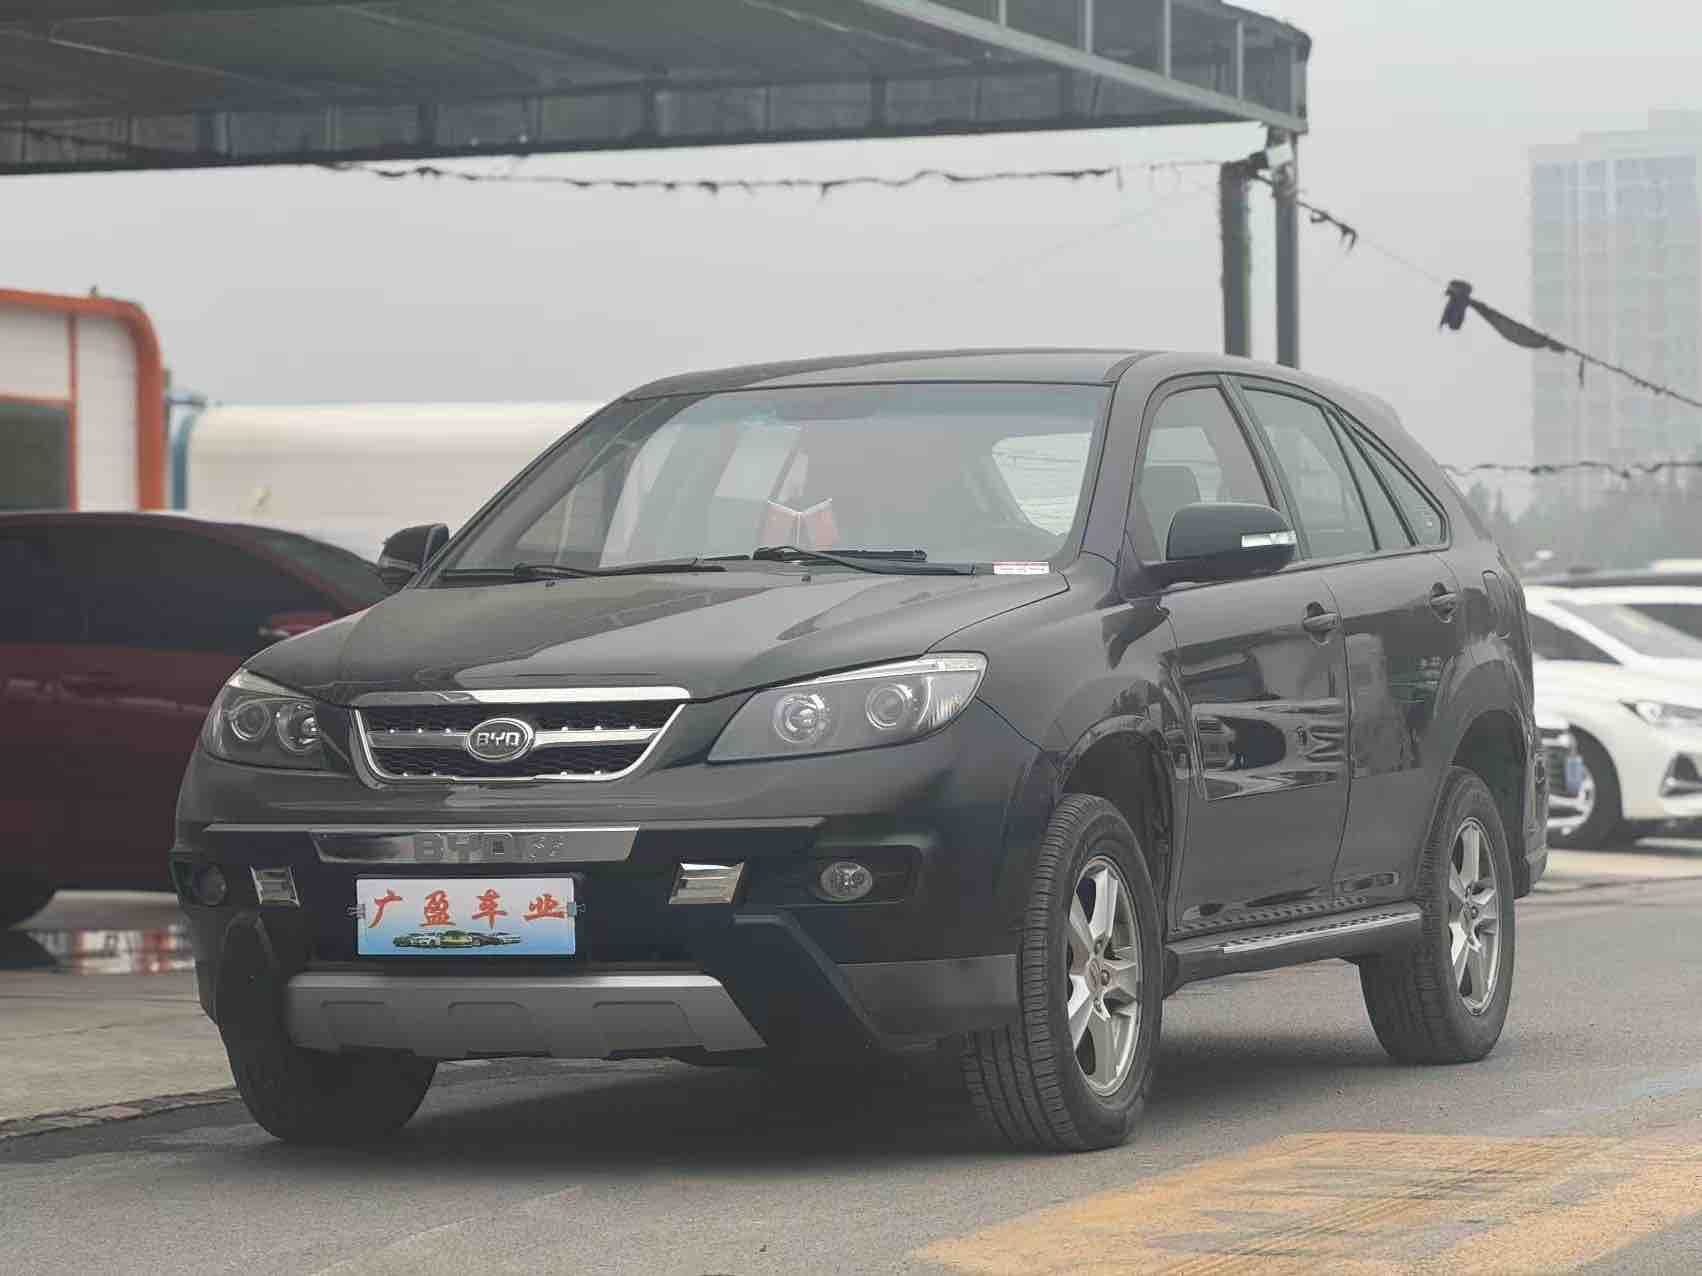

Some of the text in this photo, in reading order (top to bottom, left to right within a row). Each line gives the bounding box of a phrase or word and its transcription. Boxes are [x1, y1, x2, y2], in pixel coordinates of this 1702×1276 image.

[477, 732, 520, 746] BYD
[368, 888, 566, 929] 广盈车业
